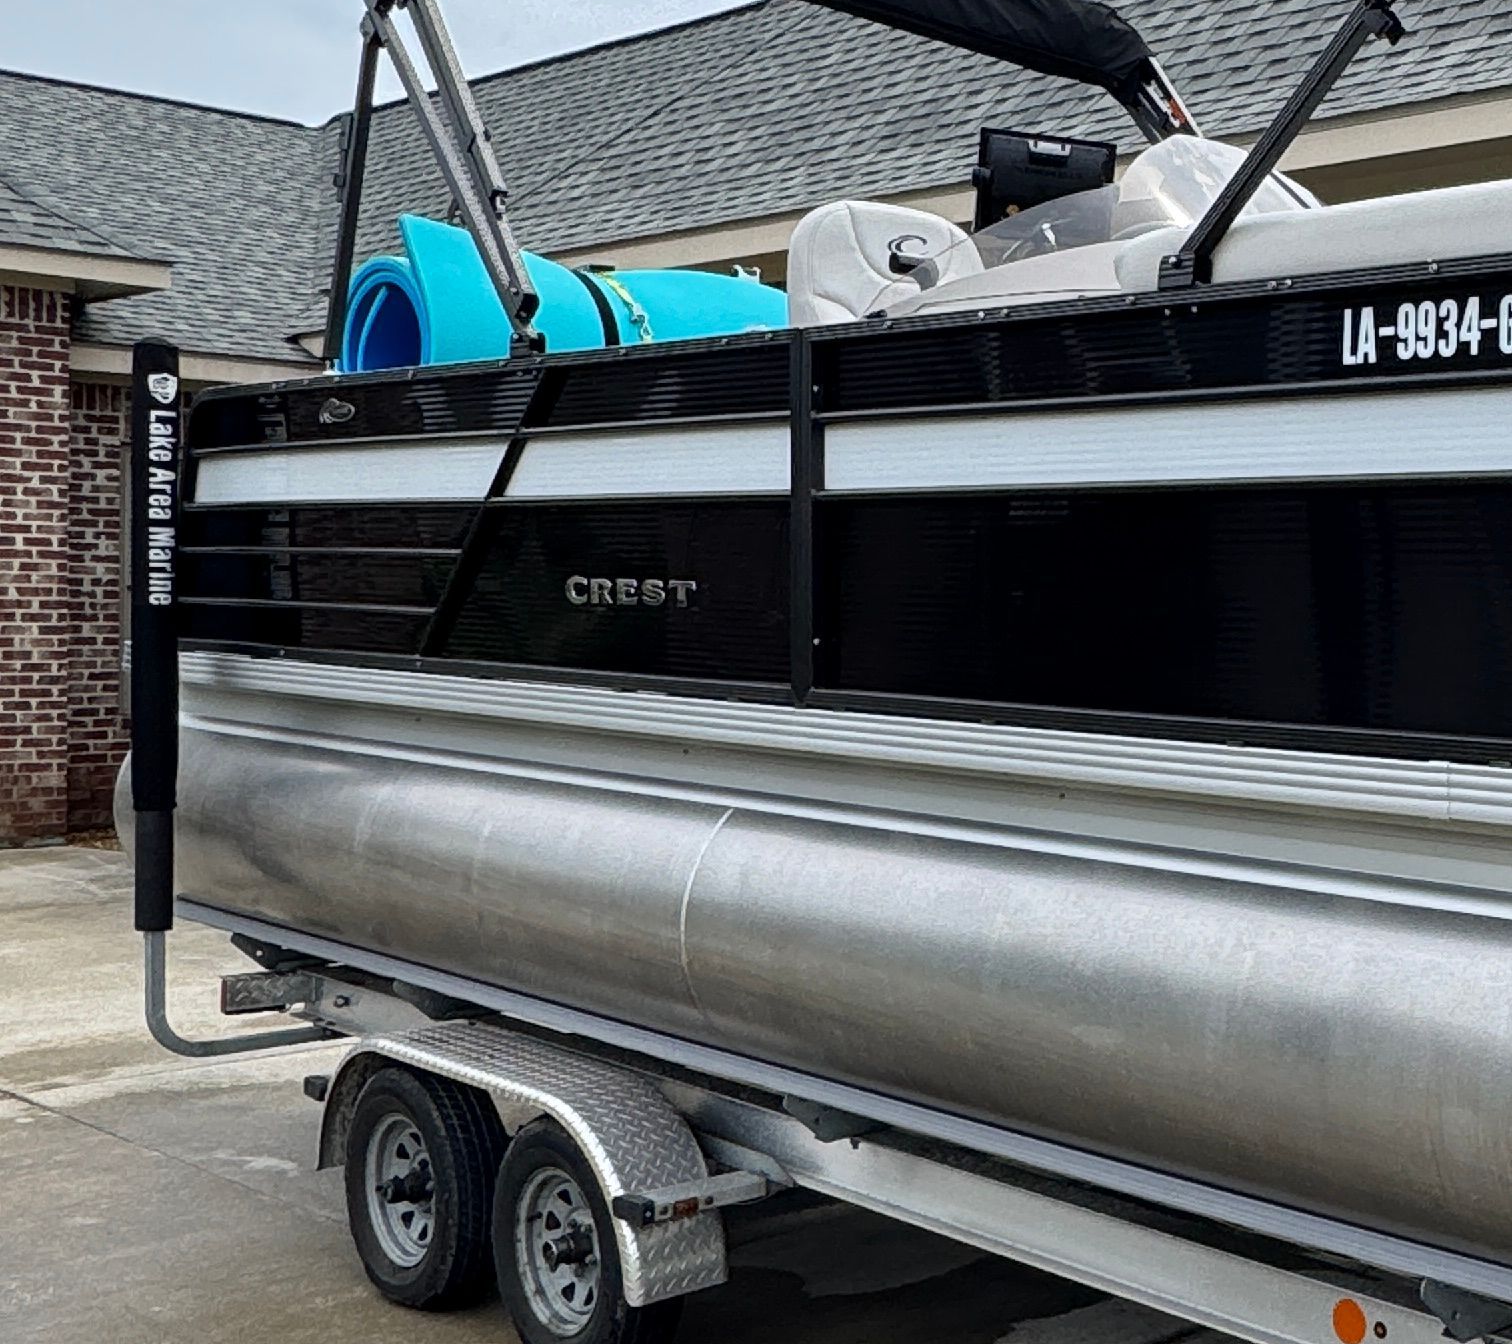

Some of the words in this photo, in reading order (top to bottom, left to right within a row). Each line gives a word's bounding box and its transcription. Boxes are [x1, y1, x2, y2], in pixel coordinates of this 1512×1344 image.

[149, 409, 177, 462] Lake
[149, 467, 175, 520] Area
[149, 526, 175, 606] Marine
[565, 575, 697, 607] CREST
